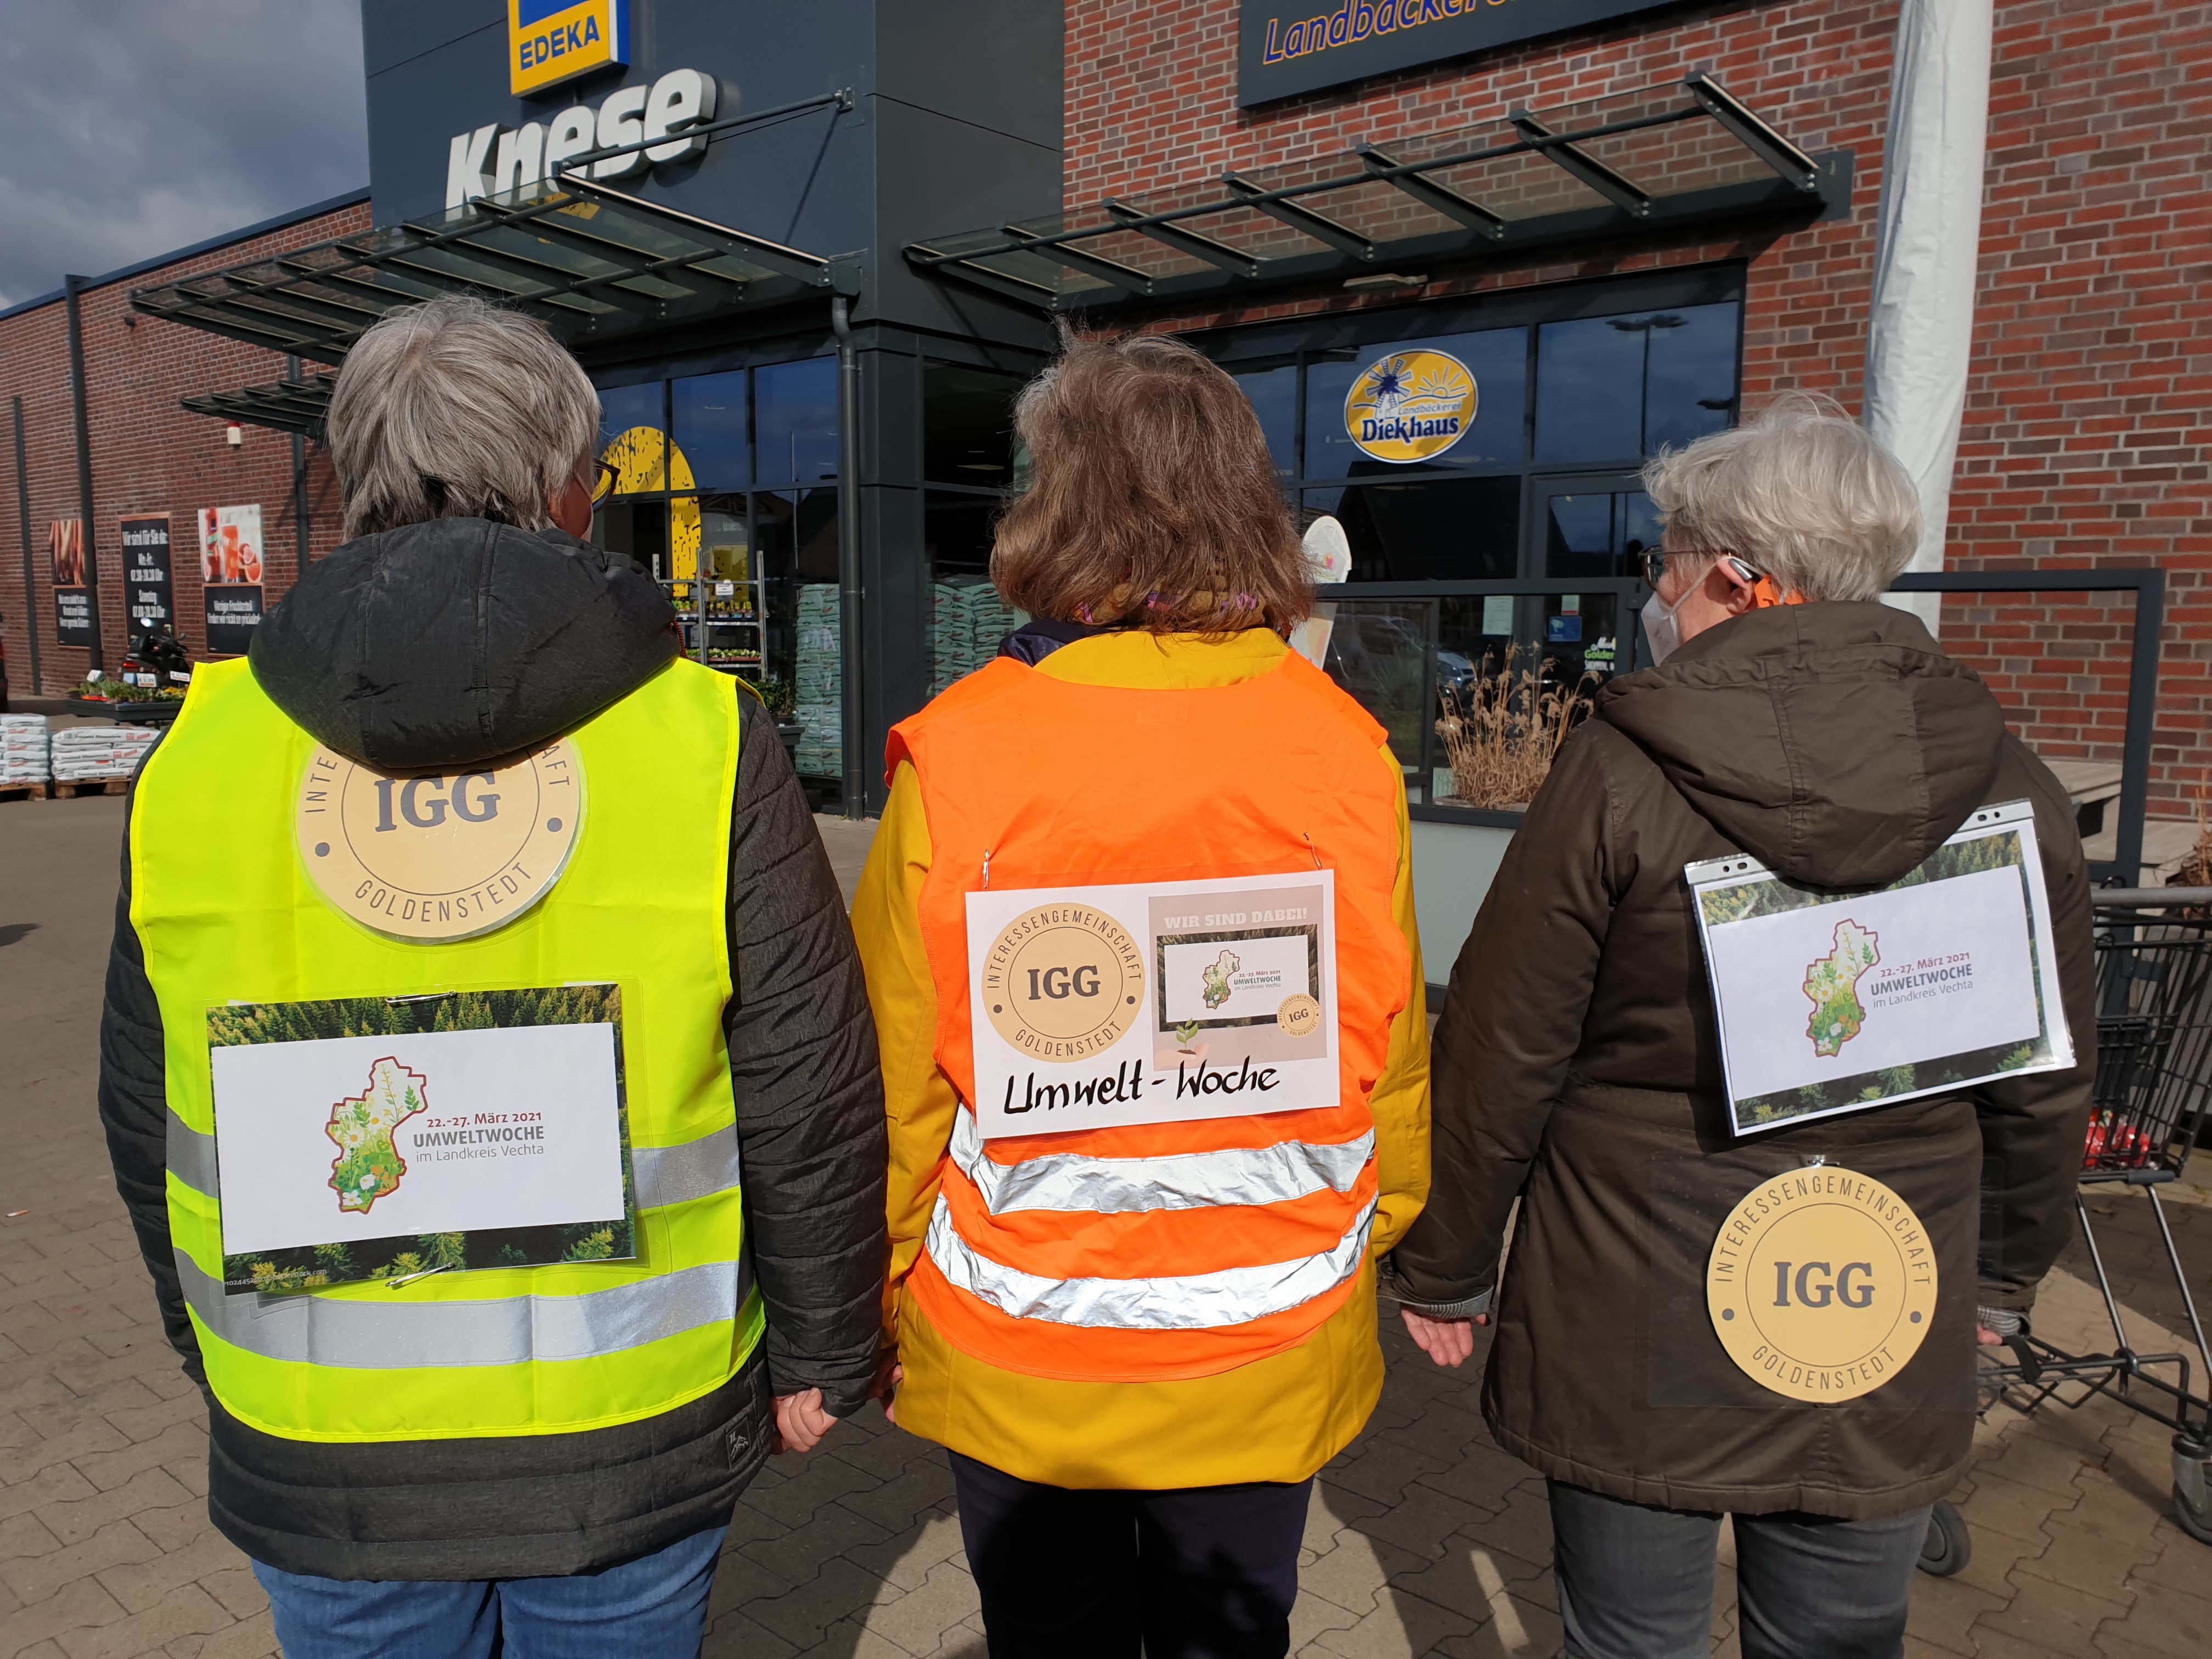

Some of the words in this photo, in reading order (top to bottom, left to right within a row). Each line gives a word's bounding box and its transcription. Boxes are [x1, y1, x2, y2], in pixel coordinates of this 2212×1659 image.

[520, 14, 600, 71] EDEKA
[445, 68, 714, 222] Knese
[1397, 400, 1463, 415] Landbäckerei
[1361, 416, 1459, 443] Diekhaus
[374, 769, 501, 833] IGG
[355, 861, 532, 922] GOLDENSTEDT
[1164, 915, 1200, 929] WIR
[1204, 912, 1247, 927] SIND
[1251, 907, 1308, 924] DABEI!
[987, 909, 1141, 989] INTERESSENGEMEINSCHAFT
[1880, 963, 1915, 978] 22.-27.
[1917, 957, 1944, 970] März
[1946, 952, 1971, 964] 2021
[1026, 964, 1101, 1001] IGG
[1234, 975, 1282, 985] UMWELTWOCHE
[1870, 963, 1973, 996] UMWELTWOCHE
[1872, 998, 1886, 1009] im
[1889, 988, 1937, 1006] Landkreis
[1939, 980, 1973, 995] Vechta
[1288, 1008, 1309, 1023] IGG
[1015, 1020, 1121, 1057] GOLDENSTEDT
[427, 1116, 471, 1128] 22.-27.
[474, 1112, 509, 1125] März
[512, 1111, 542, 1122] 2021
[413, 1125, 545, 1148] UMWELTWOCHE
[416, 1150, 432, 1163] im
[436, 1146, 497, 1161] Landkreis
[500, 1143, 544, 1156] Vechta
[1715, 1175, 1931, 1285] INTERESSENGEMEINSCHAFT
[1773, 1261, 1876, 1308] IGG
[1752, 1345, 1895, 1390] GOLDENSTEDT
